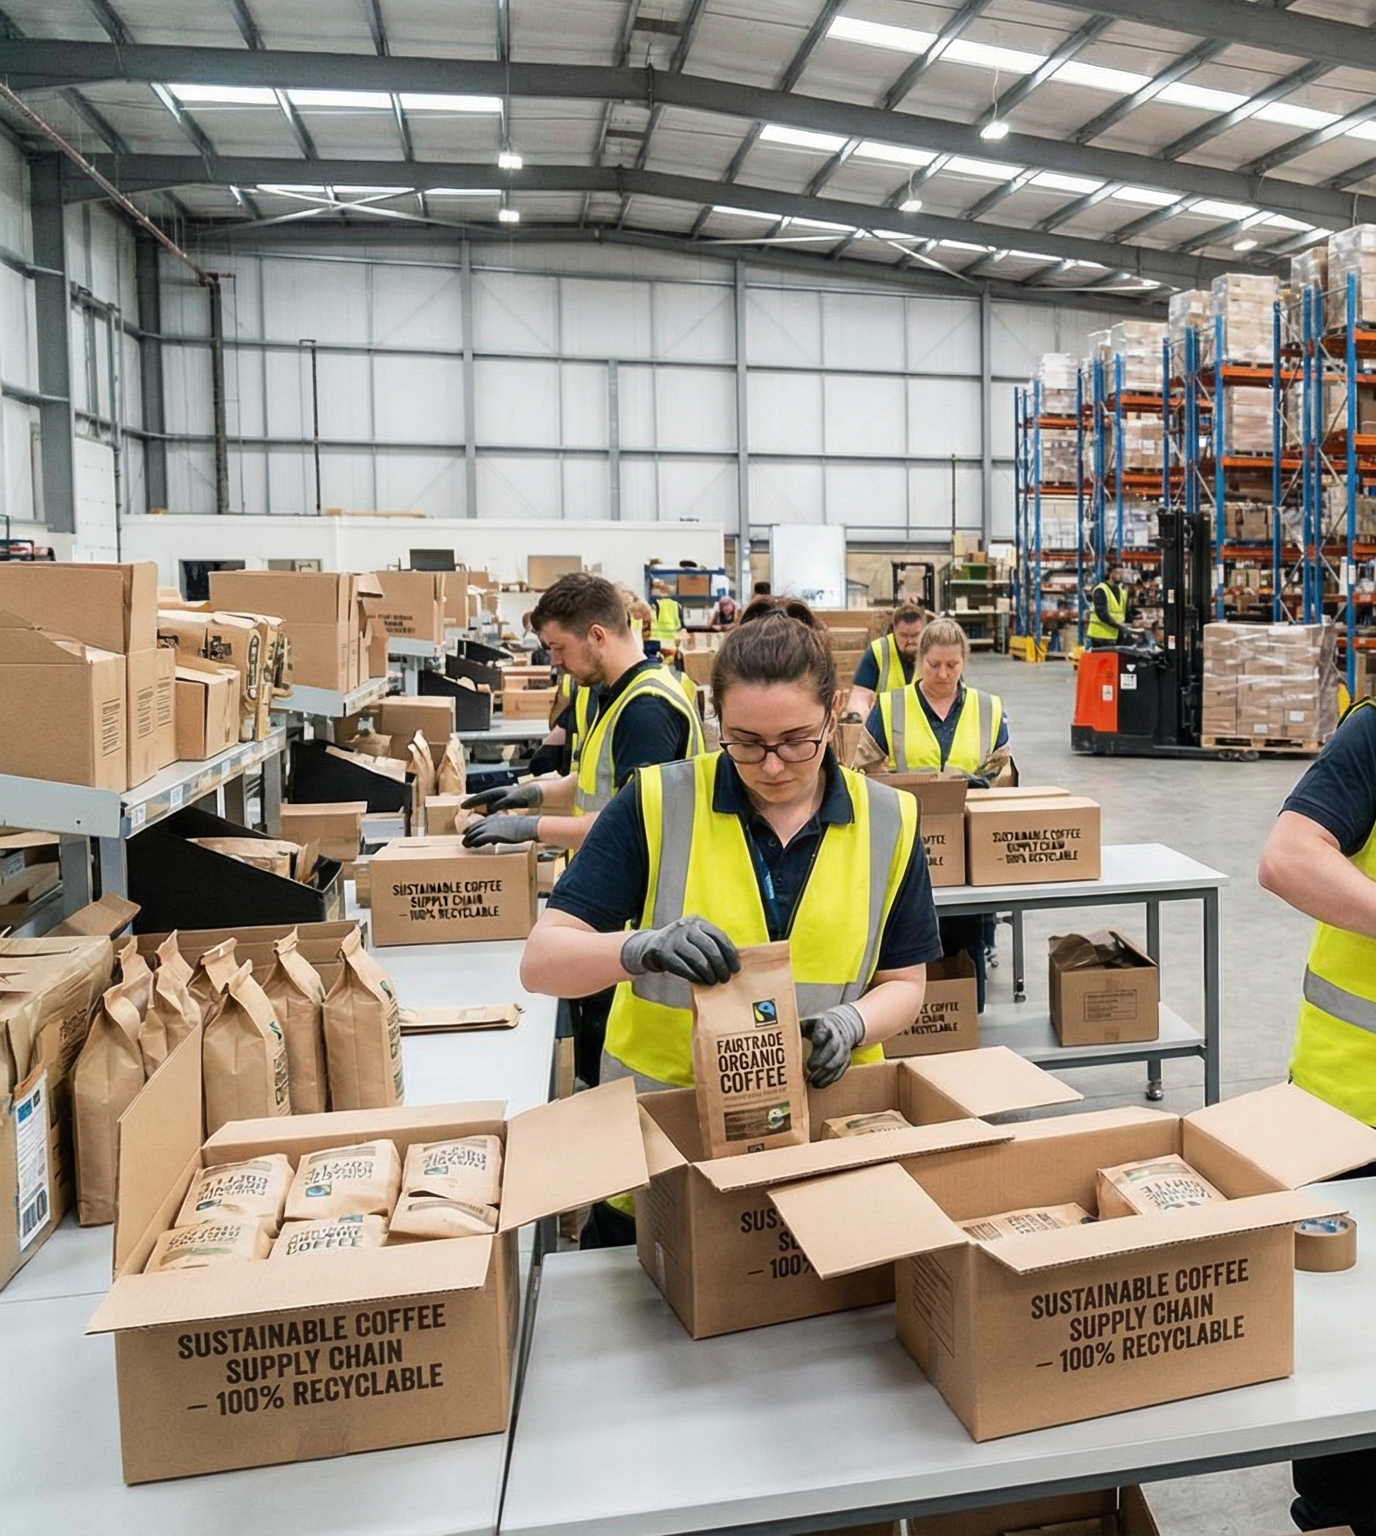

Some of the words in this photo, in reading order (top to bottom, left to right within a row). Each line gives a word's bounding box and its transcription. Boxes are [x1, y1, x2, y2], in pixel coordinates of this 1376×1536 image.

[717, 1032, 784, 1054] FAIRTRADE
[720, 1066, 787, 1094] COFFEE
[1030, 1273, 1169, 1320] SUSTAINABLE
[1175, 1258, 1249, 1290] COFFEE
[177, 1314, 348, 1360] SUSTAINABLE
[355, 1303, 446, 1338] COFFEE
[1069, 1305, 1144, 1342] SUPPLY
[1153, 1293, 1214, 1327] CHAIN
[226, 1349, 320, 1384] SUPPLY
[328, 1339, 403, 1373] CHAIN
[1059, 1338, 1116, 1373] 100%
[1122, 1315, 1245, 1362] RECYCLABLE
[216, 1385, 285, 1416] 100%
[293, 1363, 444, 1407] RECYCLABLE
